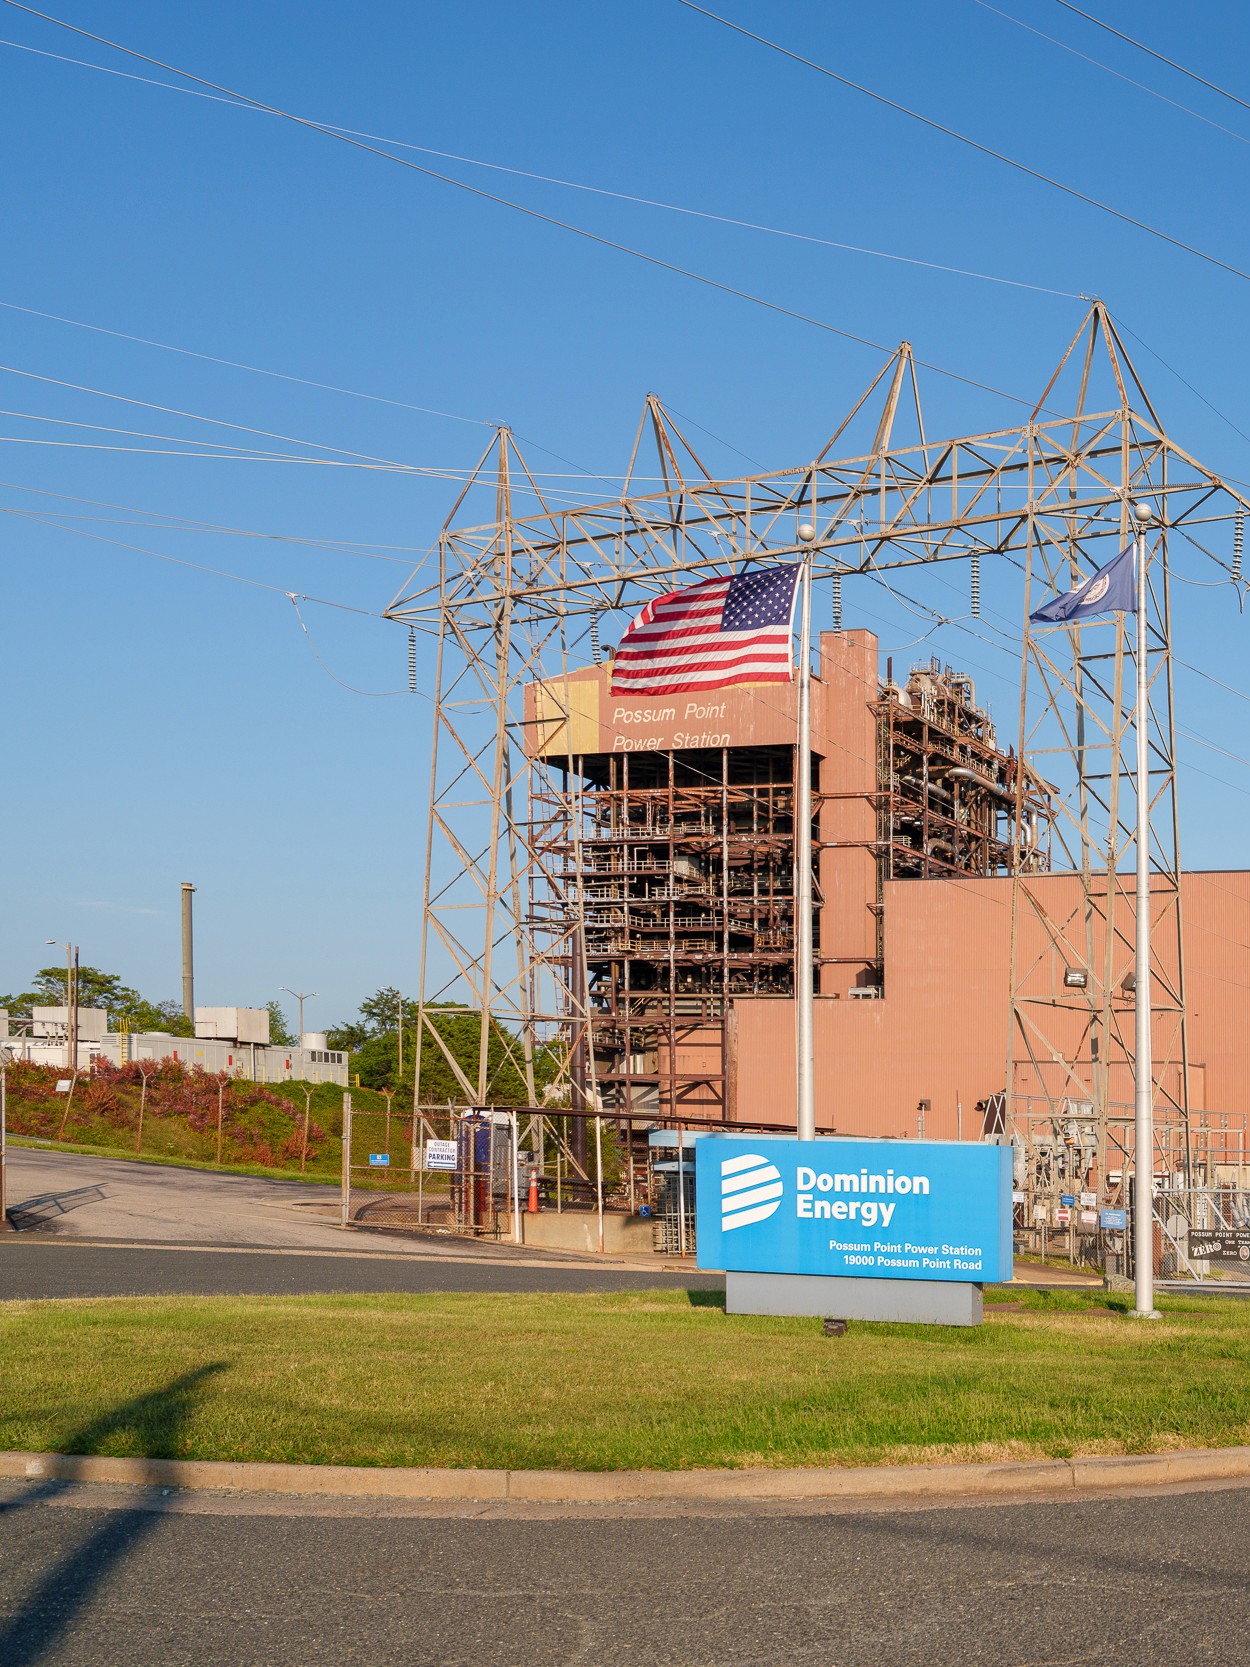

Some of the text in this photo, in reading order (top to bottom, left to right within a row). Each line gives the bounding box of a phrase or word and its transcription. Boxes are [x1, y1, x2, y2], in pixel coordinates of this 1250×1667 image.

[613, 702, 726, 724] Possum Point
[612, 731, 730, 752] Power Station
[428, 1154, 456, 1162] PARKING
[796, 1166, 930, 1195] Dominion
[796, 1194, 896, 1227] Energy
[829, 1240, 982, 1256] Possum Point Power Station
[844, 1254, 982, 1270] 19000 Possum Point Road
